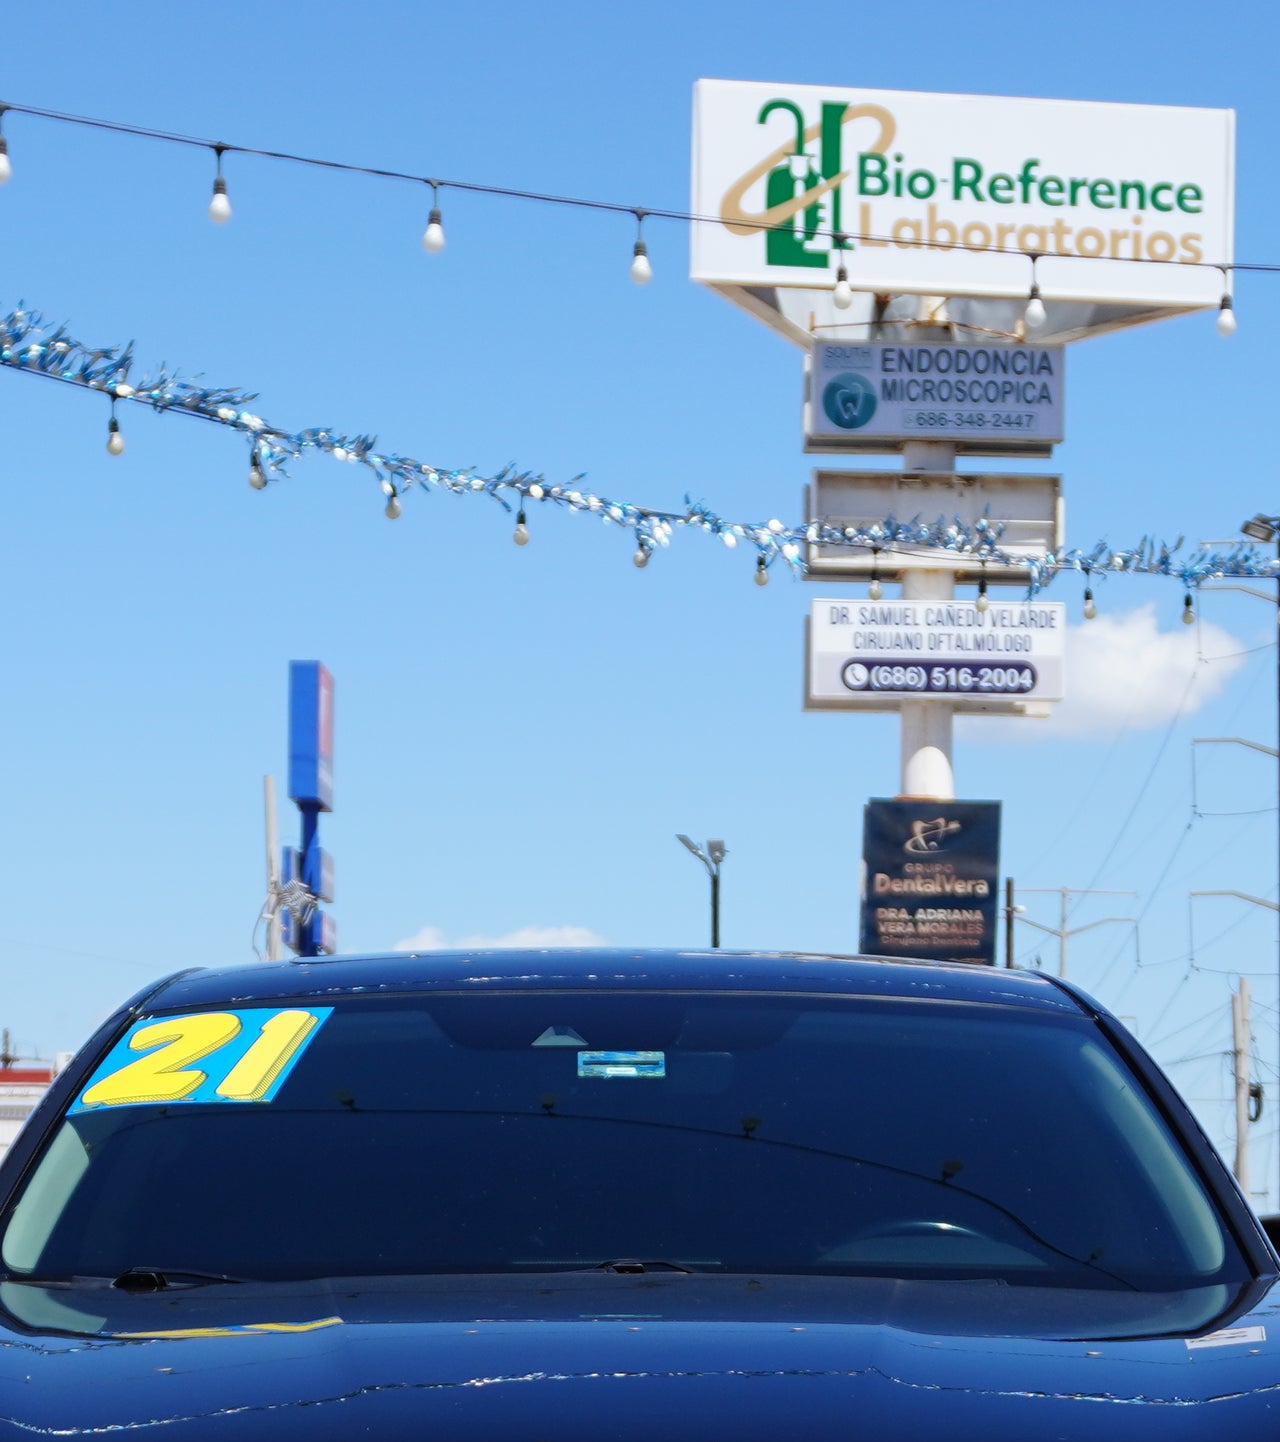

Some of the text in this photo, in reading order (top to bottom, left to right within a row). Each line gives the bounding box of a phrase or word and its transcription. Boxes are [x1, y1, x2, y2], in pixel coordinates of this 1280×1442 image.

[856, 151, 1204, 214] Bio-Reference
[858, 202, 1204, 264] Laboratorios
[880, 347, 1054, 376] ENDODONCIA
[880, 378, 1053, 405] MICROSCOPICA
[915, 411, 1035, 429] 686-348-2447
[829, 604, 1058, 630] DR. SAMUEL CAÑEDO VELARDE
[852, 631, 924, 651] CIRUJANO
[870, 664, 1034, 692] (686) 516-2004
[904, 862, 954, 874] GRUPO
[874, 873, 989, 897] DentalVera
[877, 907, 984, 921] DRA. ADRIANA
[879, 921, 984, 935] VERA MORALES
[81, 1009, 319, 1106] 21
